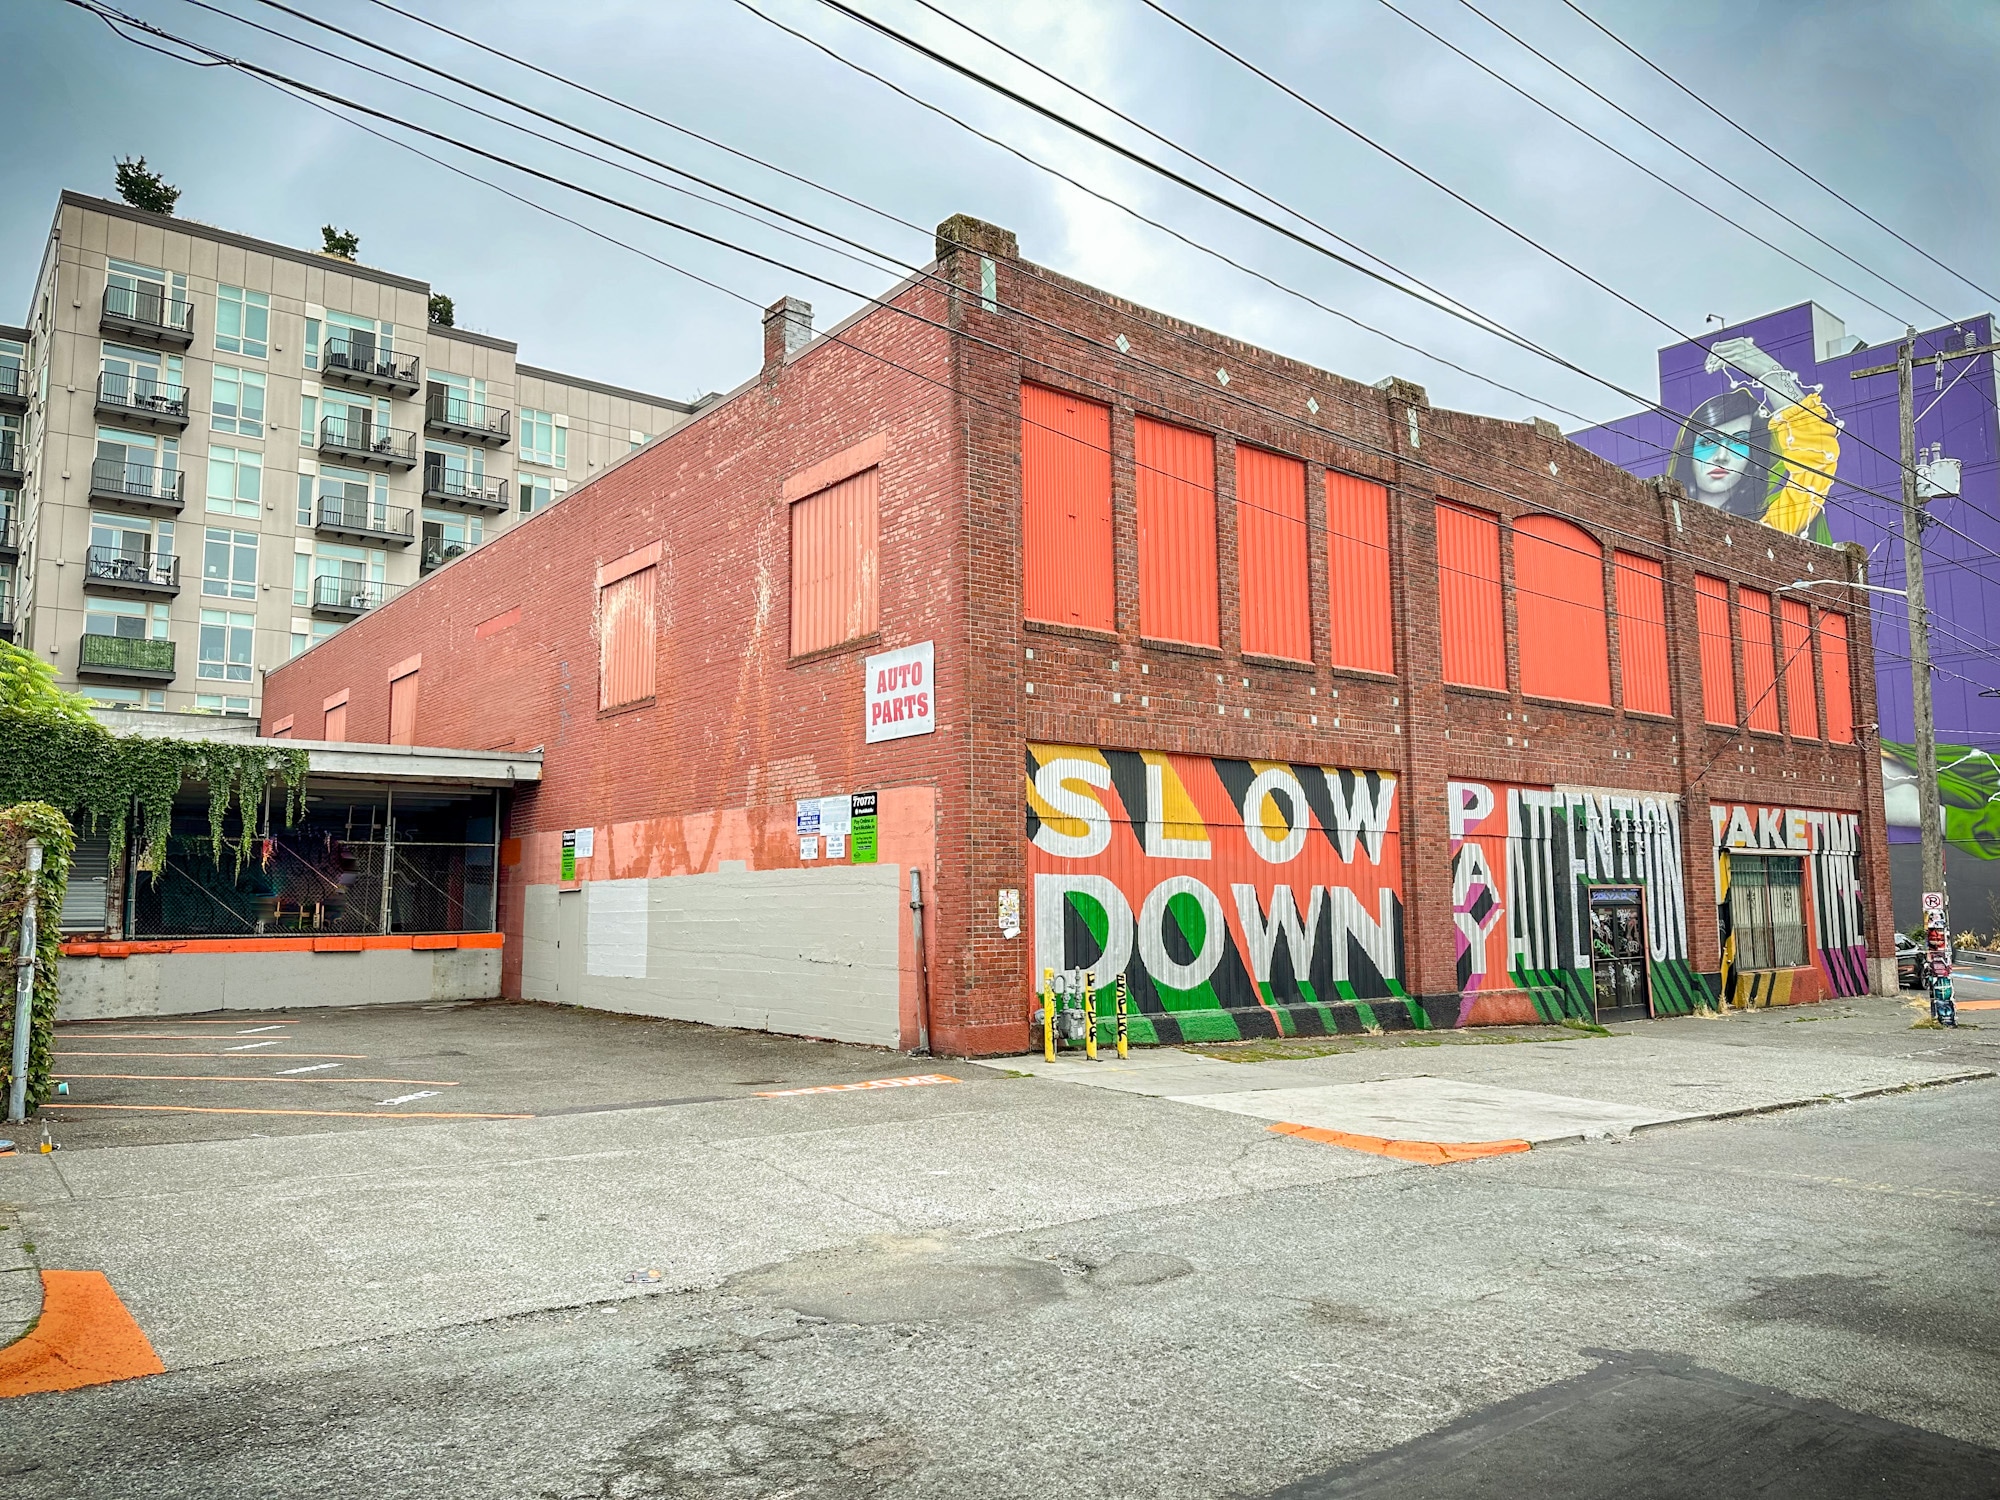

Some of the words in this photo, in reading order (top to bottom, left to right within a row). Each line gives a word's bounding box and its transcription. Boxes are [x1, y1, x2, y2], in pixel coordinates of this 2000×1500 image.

[872, 692, 928, 726] PARTS
[877, 661, 922, 694] AUTO
[1032, 757, 1397, 865] SLOW
[1577, 815, 1604, 832] AUTO
[1448, 782, 1505, 974] PAY
[1507, 787, 1688, 971] ATTENTION
[1807, 811, 1865, 950] TIME
[1034, 872, 1396, 993] DOWN
